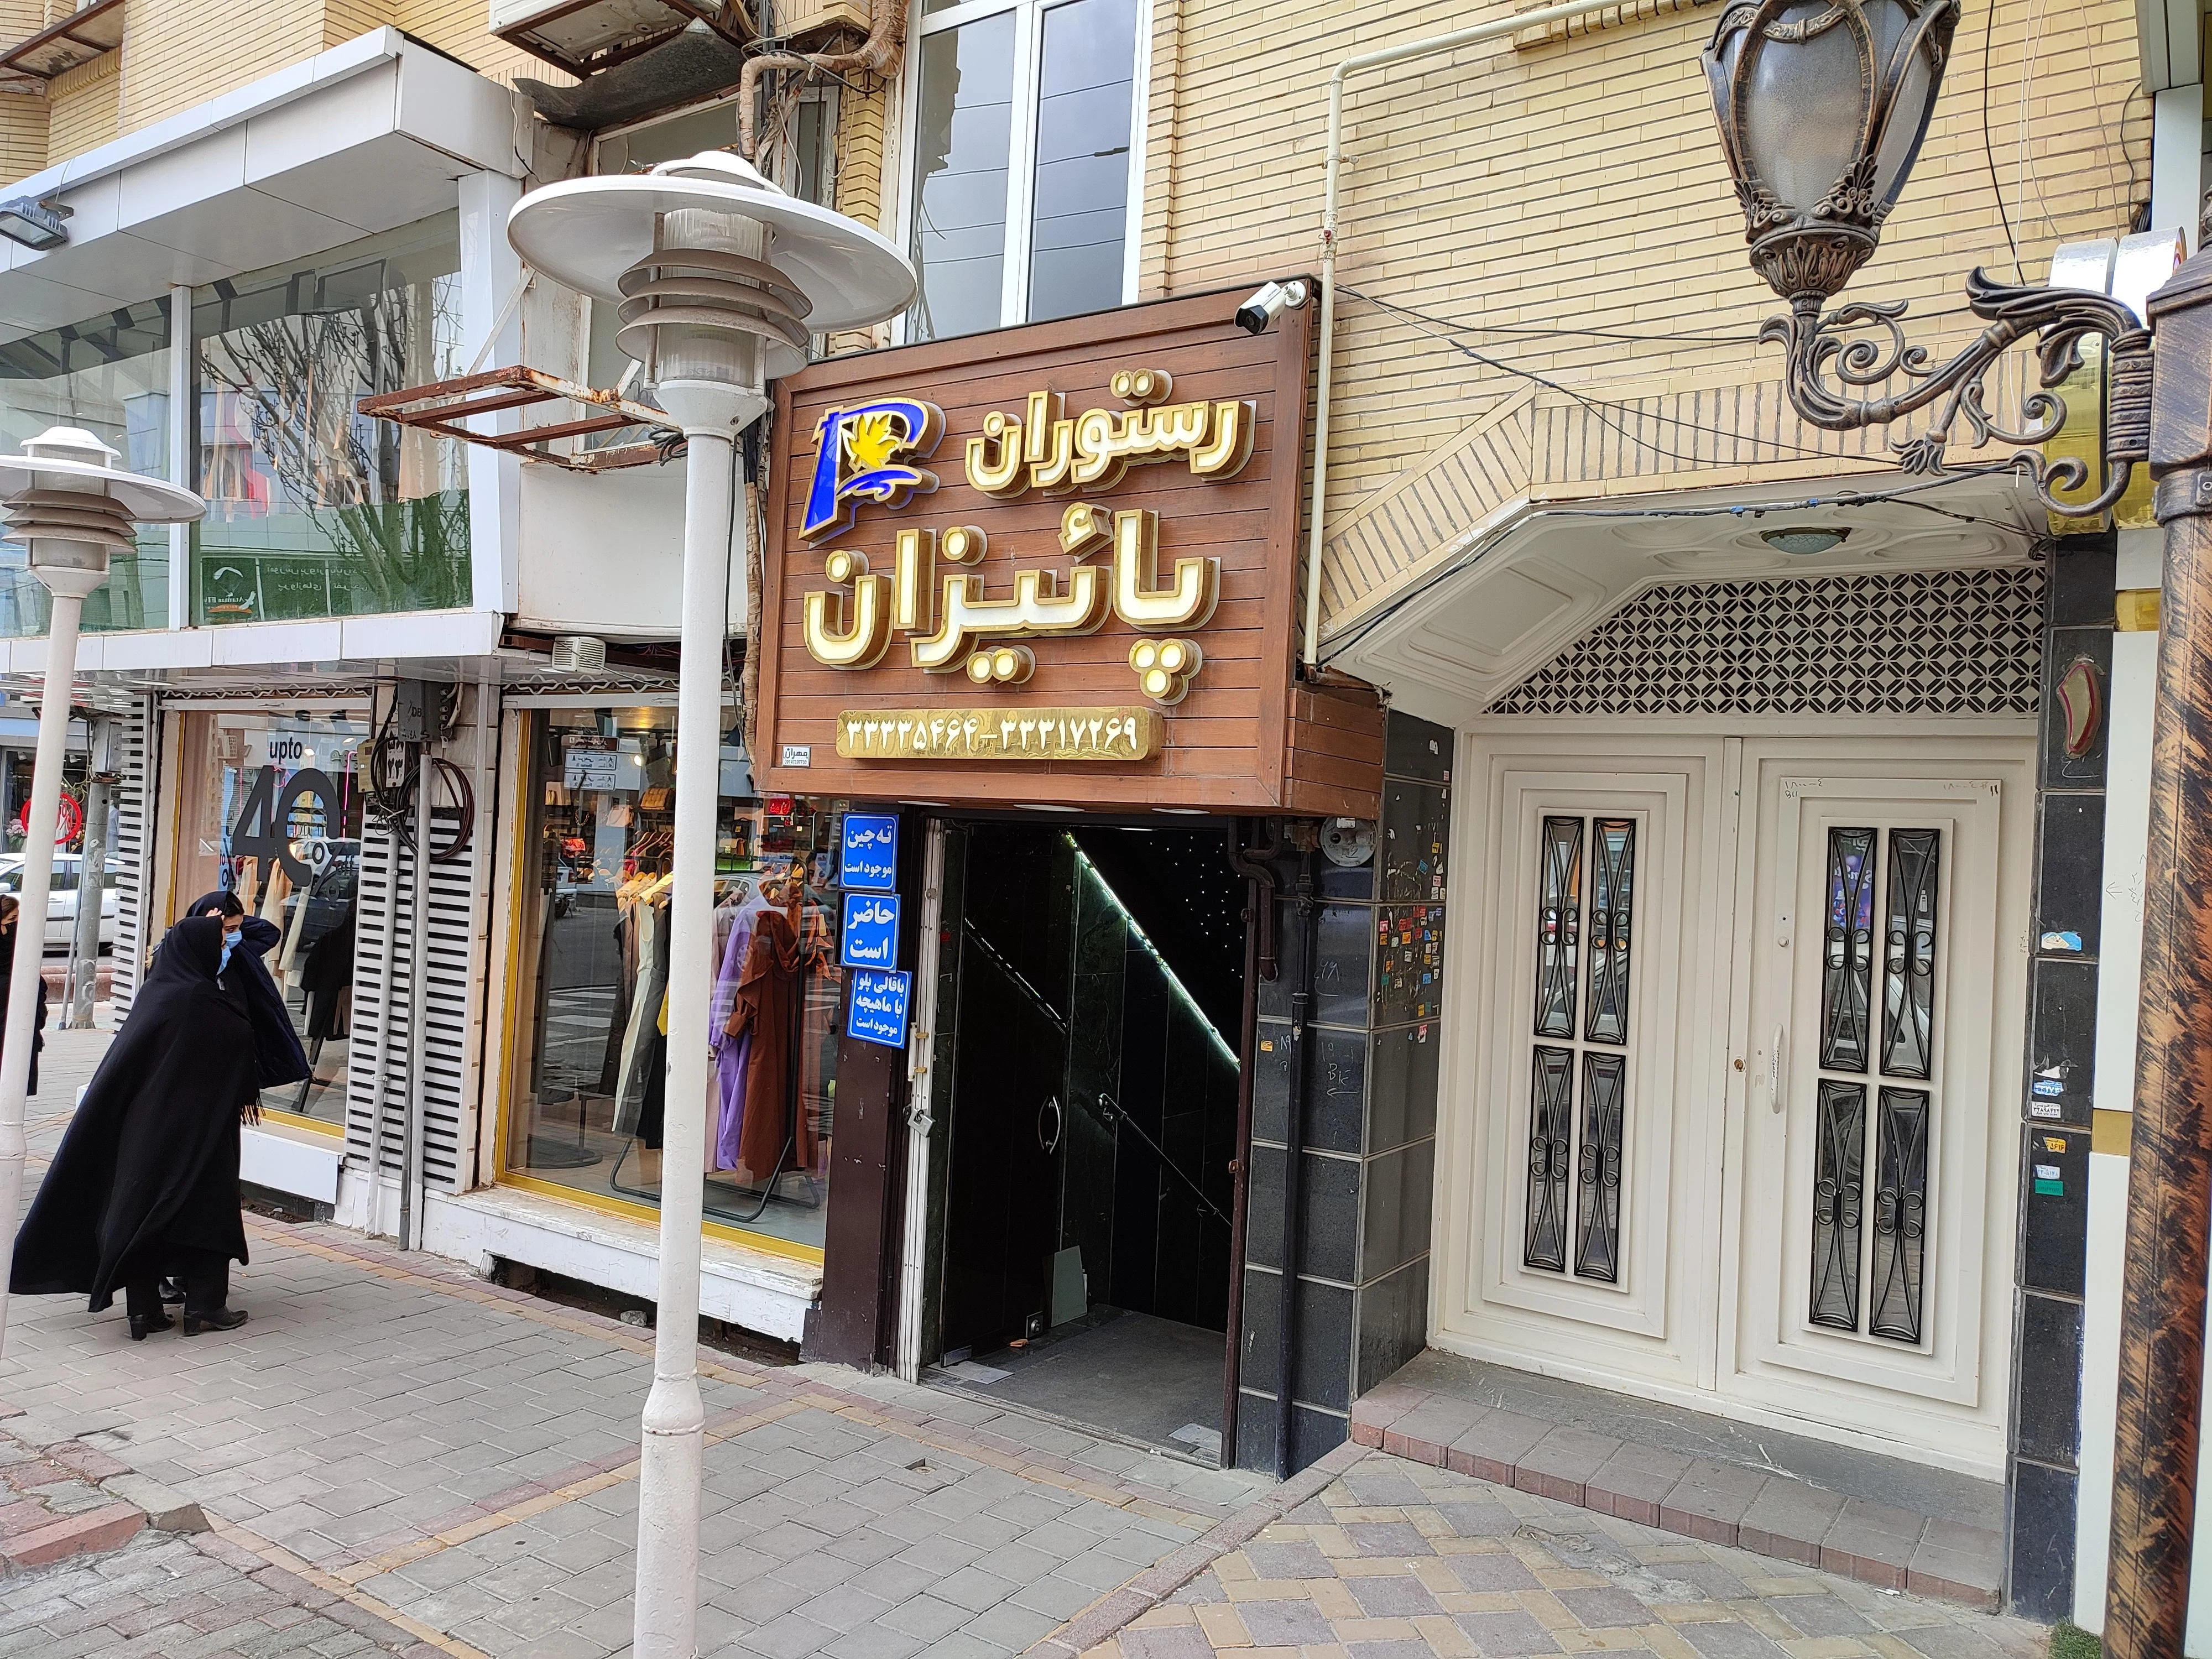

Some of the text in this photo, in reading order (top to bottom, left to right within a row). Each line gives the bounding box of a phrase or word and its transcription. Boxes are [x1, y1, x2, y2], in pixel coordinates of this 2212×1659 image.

[965, 368, 1254, 496] رستوران
[803, 502, 1219, 703] پائیزان
[269, 737, 302, 764] upto
[785, 748, 808, 759] مهران
[844, 860, 892, 878] موجود است
[847, 900, 895, 930] حاضر
[849, 936, 889, 961] است
[857, 972, 905, 998] باقالی پلو
[855, 994, 892, 1014] ماهیچه
[855, 1018, 898, 1037] موجود است
